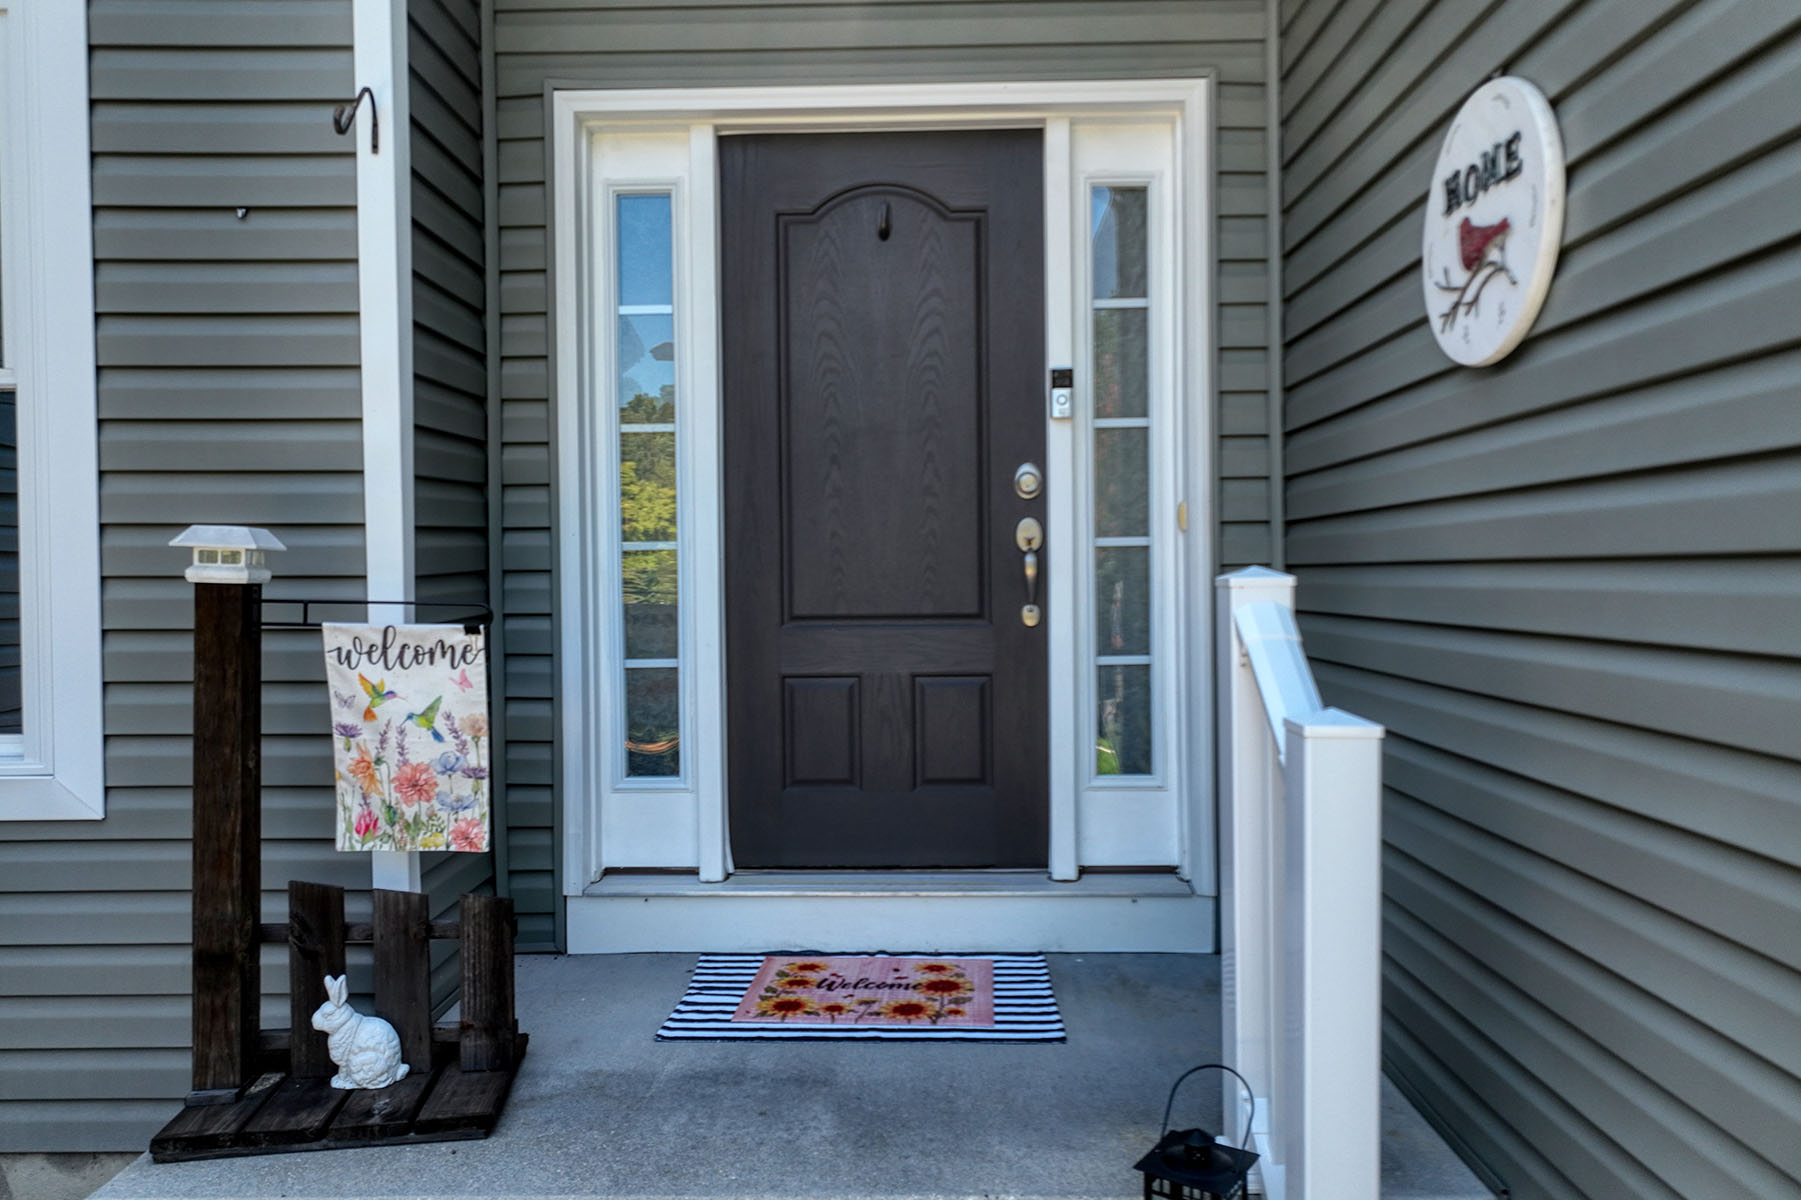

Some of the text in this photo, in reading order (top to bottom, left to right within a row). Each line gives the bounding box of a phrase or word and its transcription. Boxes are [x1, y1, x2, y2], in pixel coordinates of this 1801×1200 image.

[1443, 131, 1522, 216] HOME
[327, 625, 485, 671] welcome
[816, 977, 923, 992] Welcome
